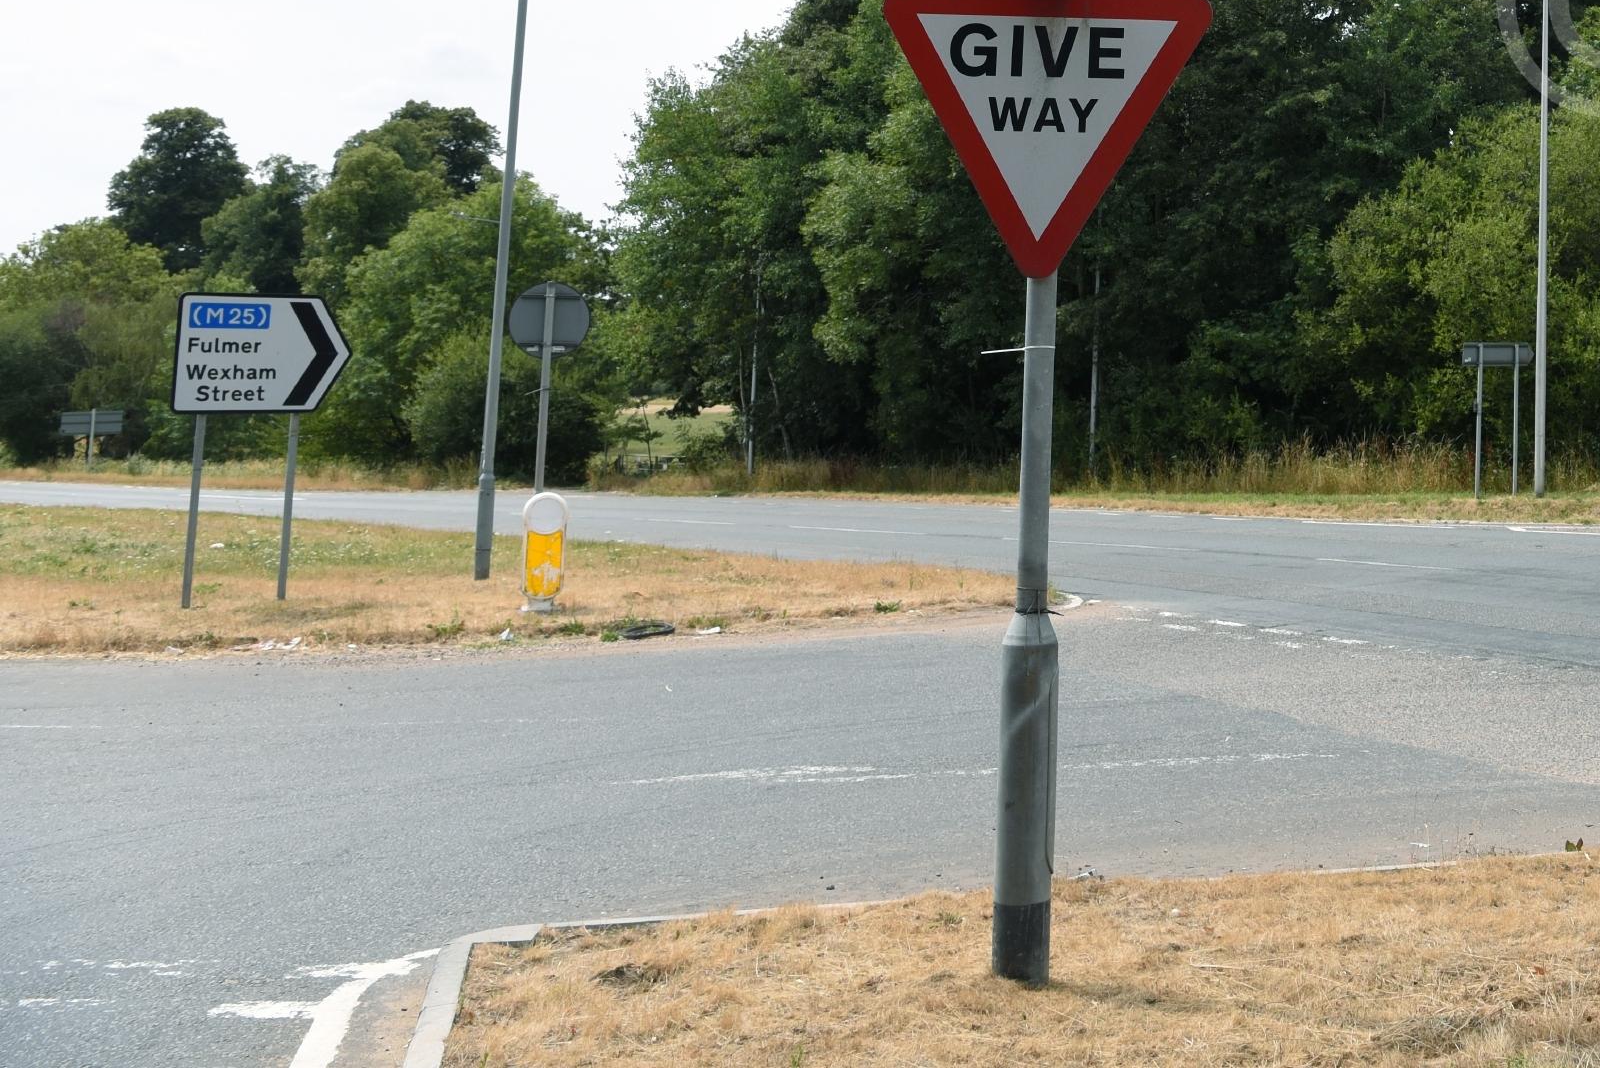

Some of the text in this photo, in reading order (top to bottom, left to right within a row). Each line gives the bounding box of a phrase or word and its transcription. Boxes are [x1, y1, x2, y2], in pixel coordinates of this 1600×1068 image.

[949, 22, 1126, 79] GIVE
[988, 96, 1099, 133] WAY
[188, 337, 262, 353] Fulmer
[186, 364, 276, 380] Wexham
[195, 385, 265, 401] Street
